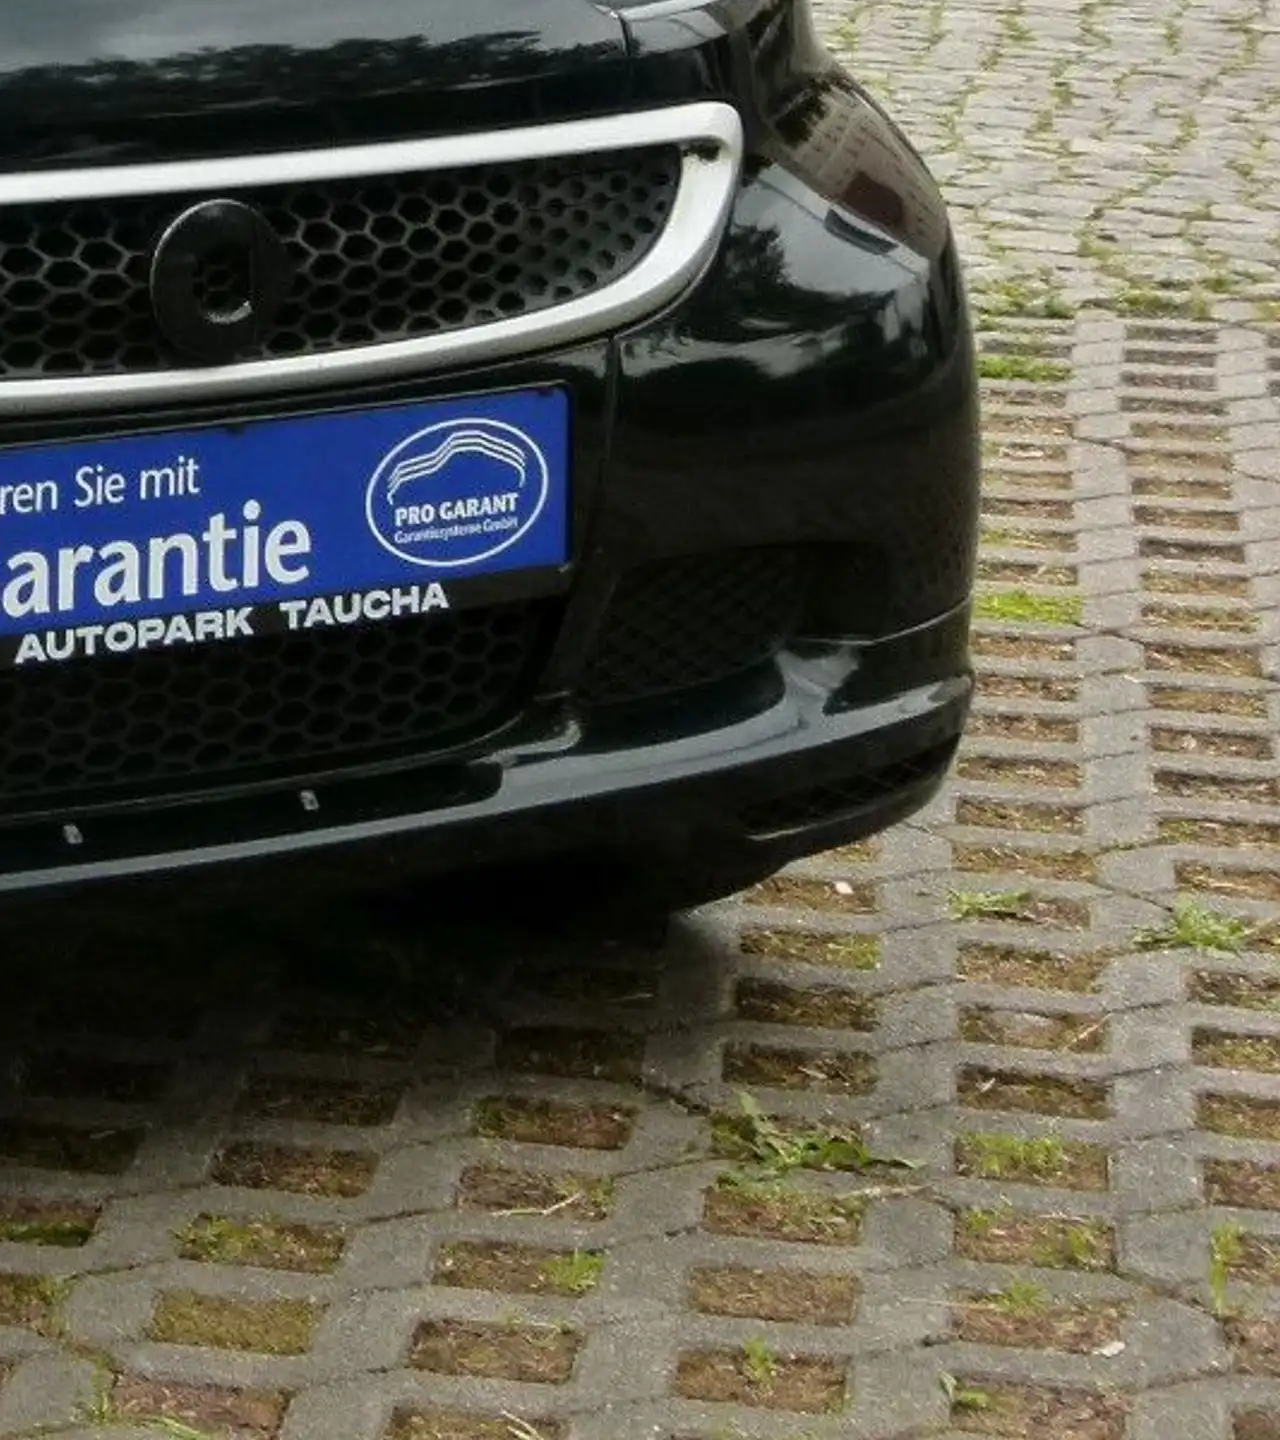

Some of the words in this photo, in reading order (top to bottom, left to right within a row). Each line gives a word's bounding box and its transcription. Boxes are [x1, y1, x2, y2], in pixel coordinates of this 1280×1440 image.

[74, 464, 126, 508] Sie
[140, 455, 200, 500] mit
[394, 503, 435, 527] PRO
[438, 491, 519, 520] GARANT
[14, 606, 255, 665] AUTOPARK
[279, 582, 450, 630] TAUCHA
